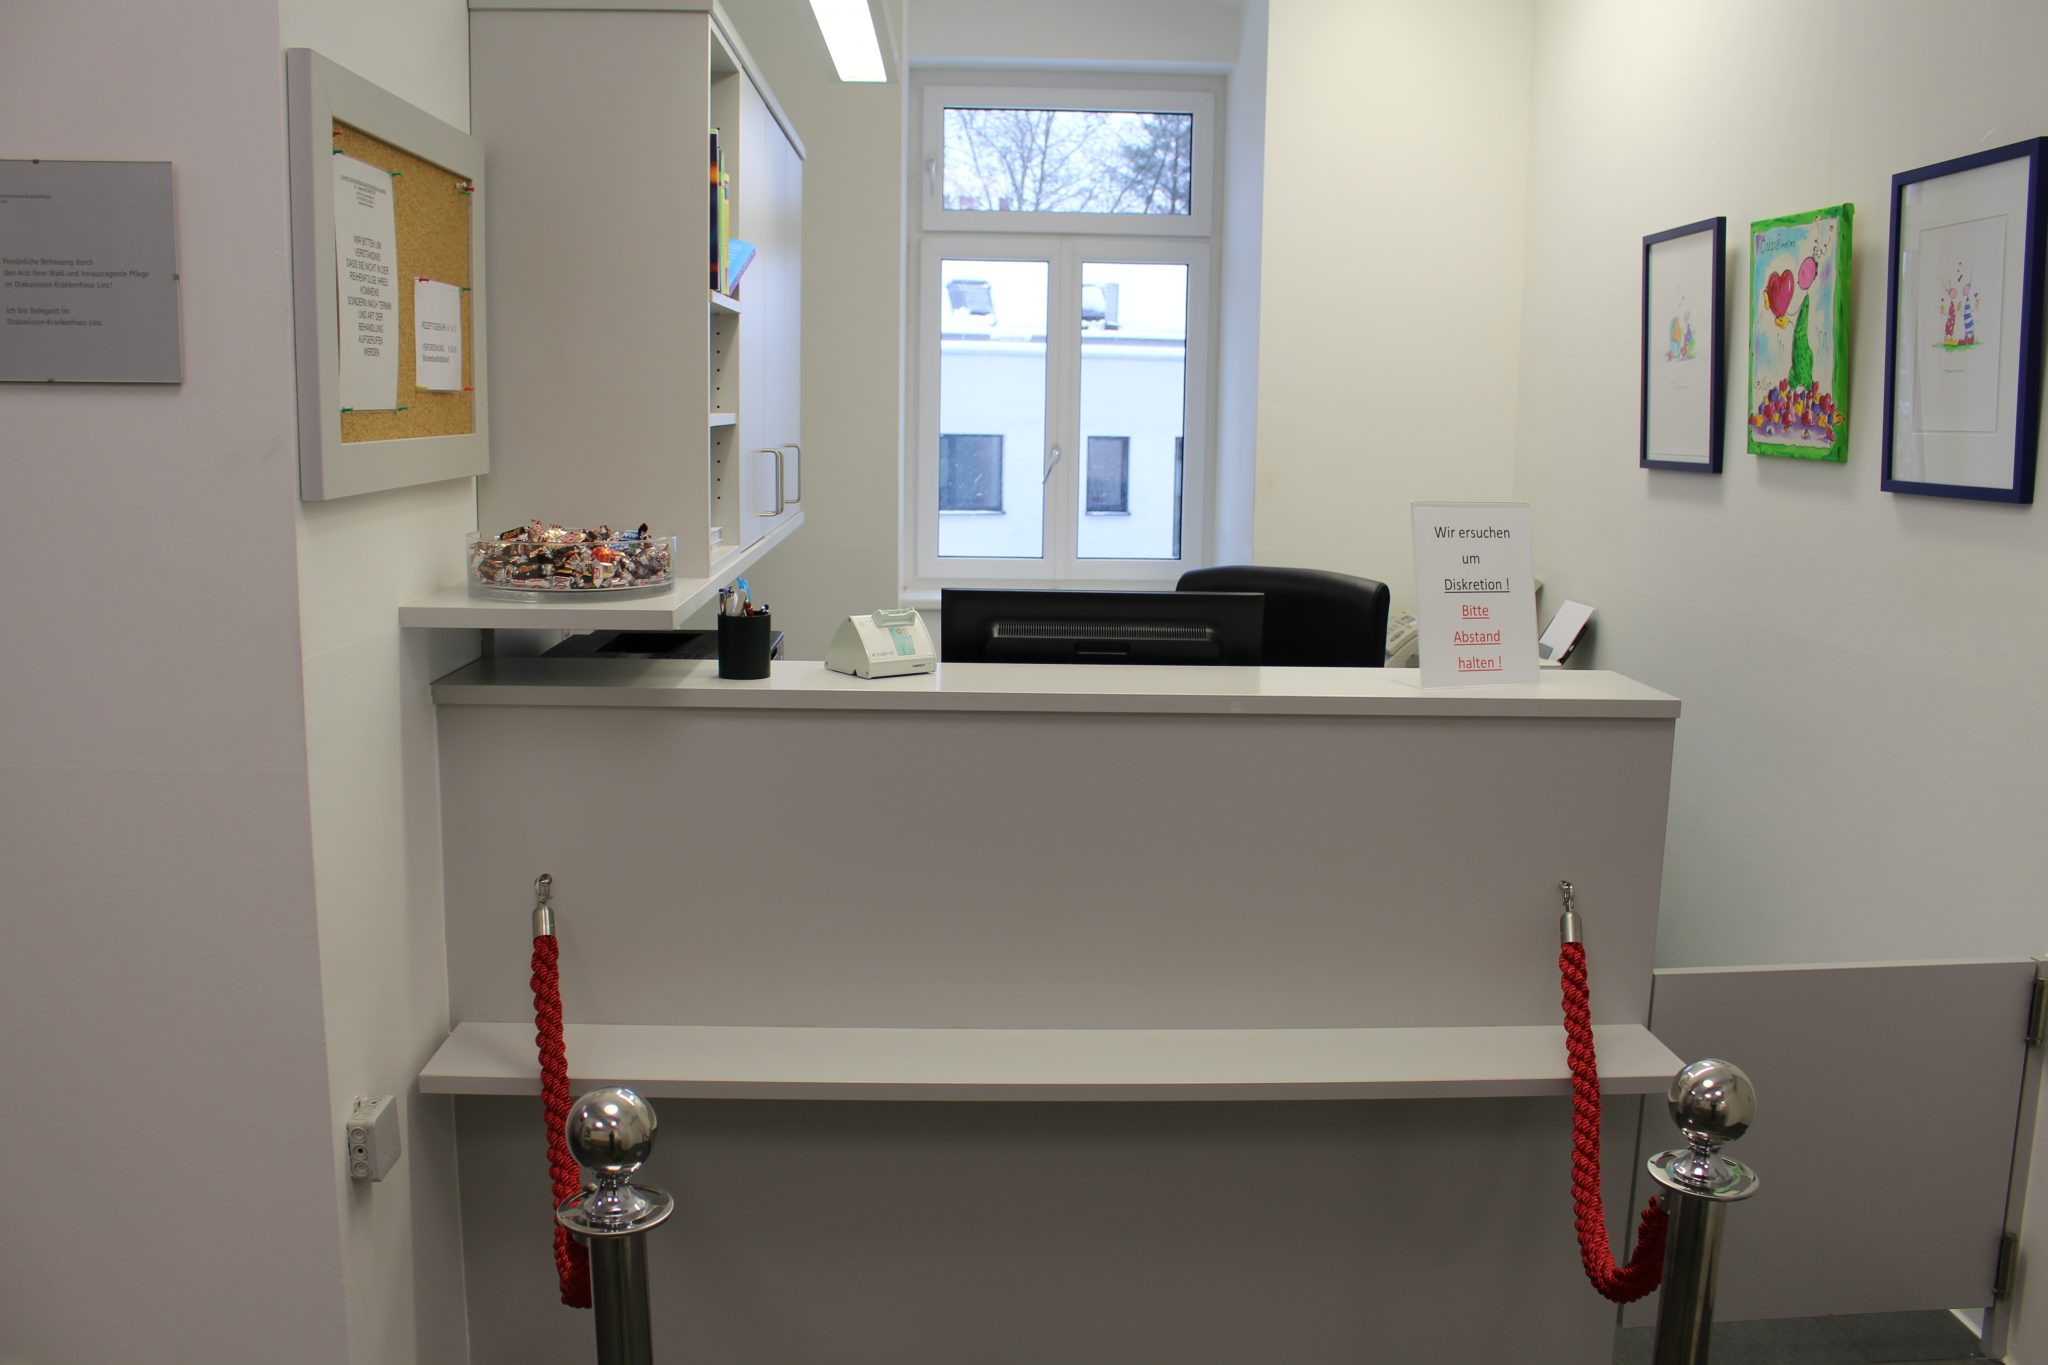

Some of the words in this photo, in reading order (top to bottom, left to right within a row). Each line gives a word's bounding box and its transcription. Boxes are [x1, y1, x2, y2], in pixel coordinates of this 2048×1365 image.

[2, 257, 39, 266] Persönliche
[40, 257, 74, 267] Betreuung
[75, 257, 94, 266] durch
[3, 269, 16, 277] den
[17, 269, 31, 277] Arzt
[32, 269, 48, 277] Ihrer
[49, 269, 65, 277] Wahl
[66, 269, 79, 277] und
[81, 269, 128, 279] herausragende
[129, 269, 150, 279] Pflege
[14, 281, 95, 289] Diakonissen-Krankenhaus
[30, 307, 60, 316] Belegarzt
[7, 318, 87, 327] Diakonissen-Krankenhaus
[1434, 526, 1455, 539] Wir
[1458, 525, 1511, 539] ersuchen
[1462, 554, 1480, 565] um
[1444, 577, 1502, 591] Diskretion
[1461, 604, 1489, 617] Bitte
[1453, 629, 1501, 643] Abstand
[1458, 656, 1495, 670] halten
